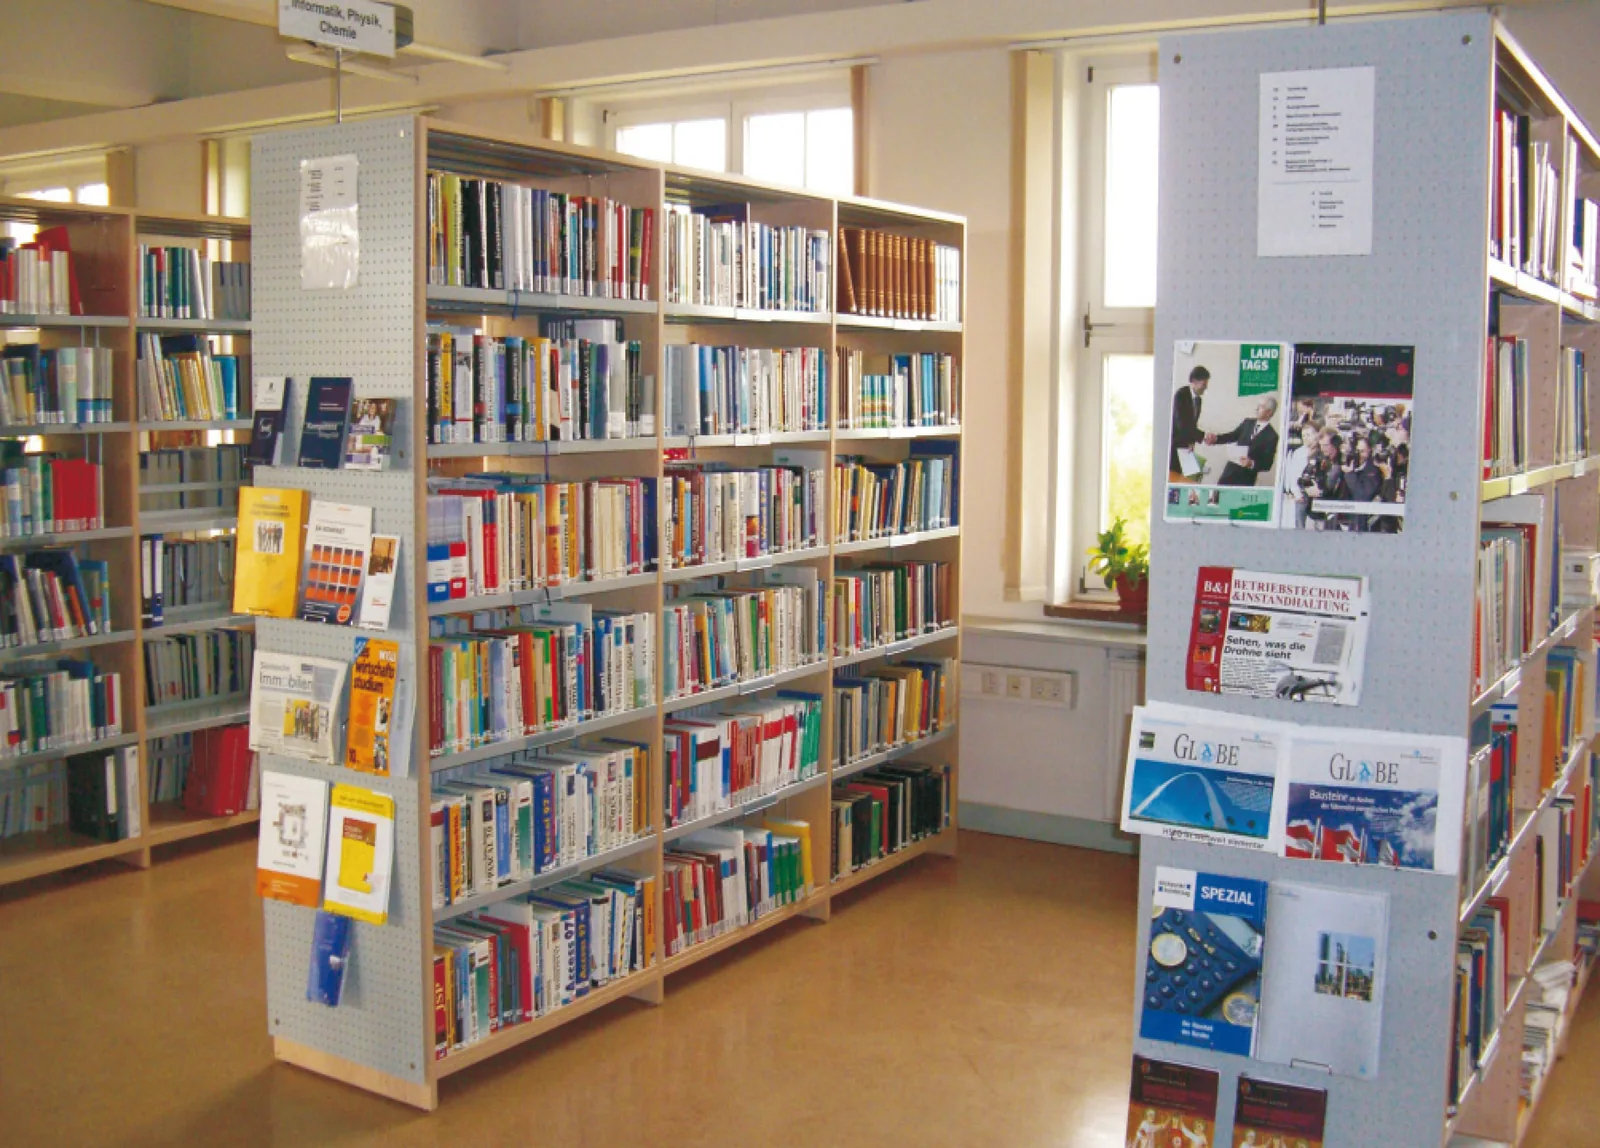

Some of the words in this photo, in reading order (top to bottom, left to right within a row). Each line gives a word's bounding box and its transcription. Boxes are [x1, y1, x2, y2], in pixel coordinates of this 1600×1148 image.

[347, 8, 382, 28] Physik,
[320, 20, 357, 39] Chemie
[1250, 348, 1279, 359] LAND
[1241, 359, 1270, 371] TAGS
[1203, 580, 1229, 595] B&I
[1233, 578, 1350, 601] BETRIEBSTECHNIK
[1226, 635, 1261, 649] Sehen,
[1264, 641, 1287, 651] was
[1289, 642, 1306, 652] die
[1224, 646, 1262, 657] Drohne
[1264, 649, 1292, 660] sieht
[353, 677, 384, 693] studium
[1309, 789, 1349, 803] Bausteine
[1200, 885, 1255, 907] SPEZIAL
[563, 921, 574, 940] 97
[565, 940, 576, 991] Access
